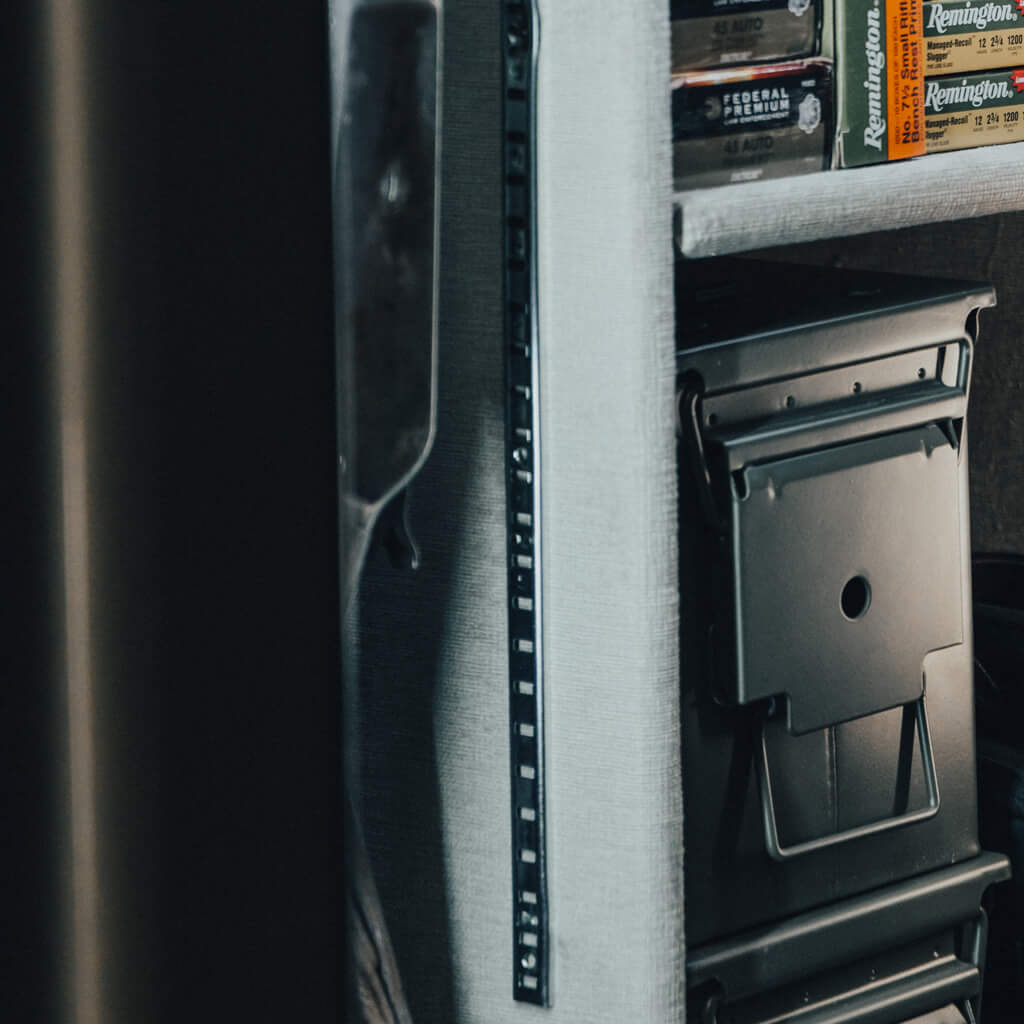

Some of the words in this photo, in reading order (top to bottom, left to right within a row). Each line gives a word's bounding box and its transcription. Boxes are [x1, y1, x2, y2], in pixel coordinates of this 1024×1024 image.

[926, 1, 1014, 33] Remington
[900, 34, 910, 80] Small
[978, 38, 987, 48] 12
[1007, 34, 1023, 45] 1200
[909, 41, 919, 80] Rest
[863, 7, 886, 151] Remington
[723, 87, 789, 105] FEDERAL
[723, 99, 790, 118] PREMIUM
[925, 79, 1010, 112] Remington
[901, 116, 911, 144] No.
[910, 86, 920, 143] Bench
[974, 116, 983, 126] 12
[1003, 111, 1019, 122] 1200
